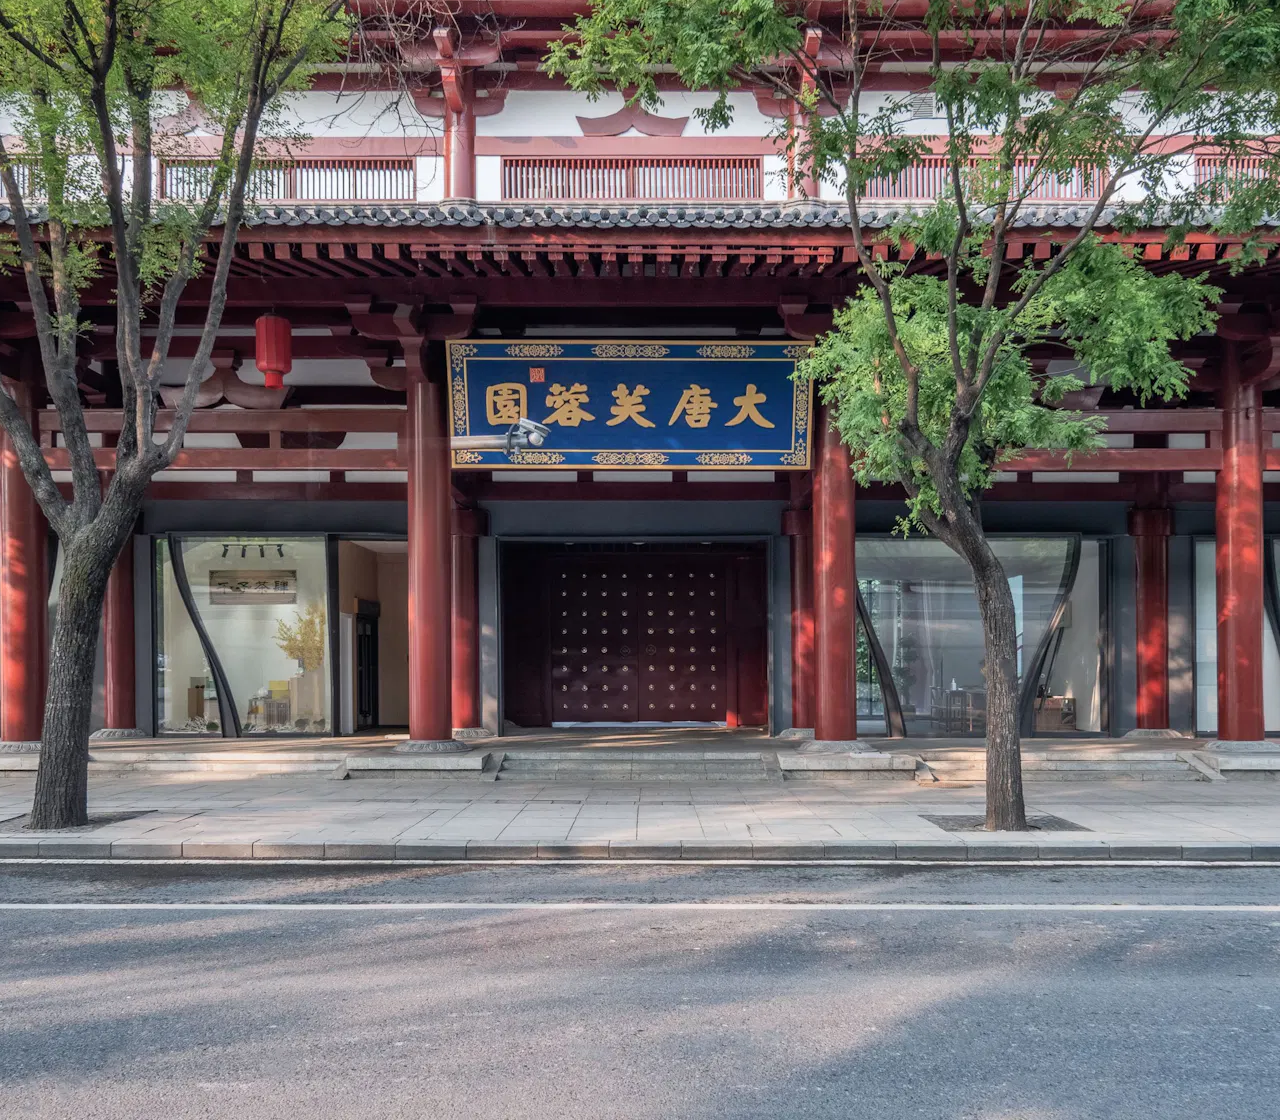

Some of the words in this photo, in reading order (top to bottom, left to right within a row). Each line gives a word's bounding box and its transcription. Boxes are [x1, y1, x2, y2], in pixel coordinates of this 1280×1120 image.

[486, 383, 775, 429] 大唐芙蓉園
